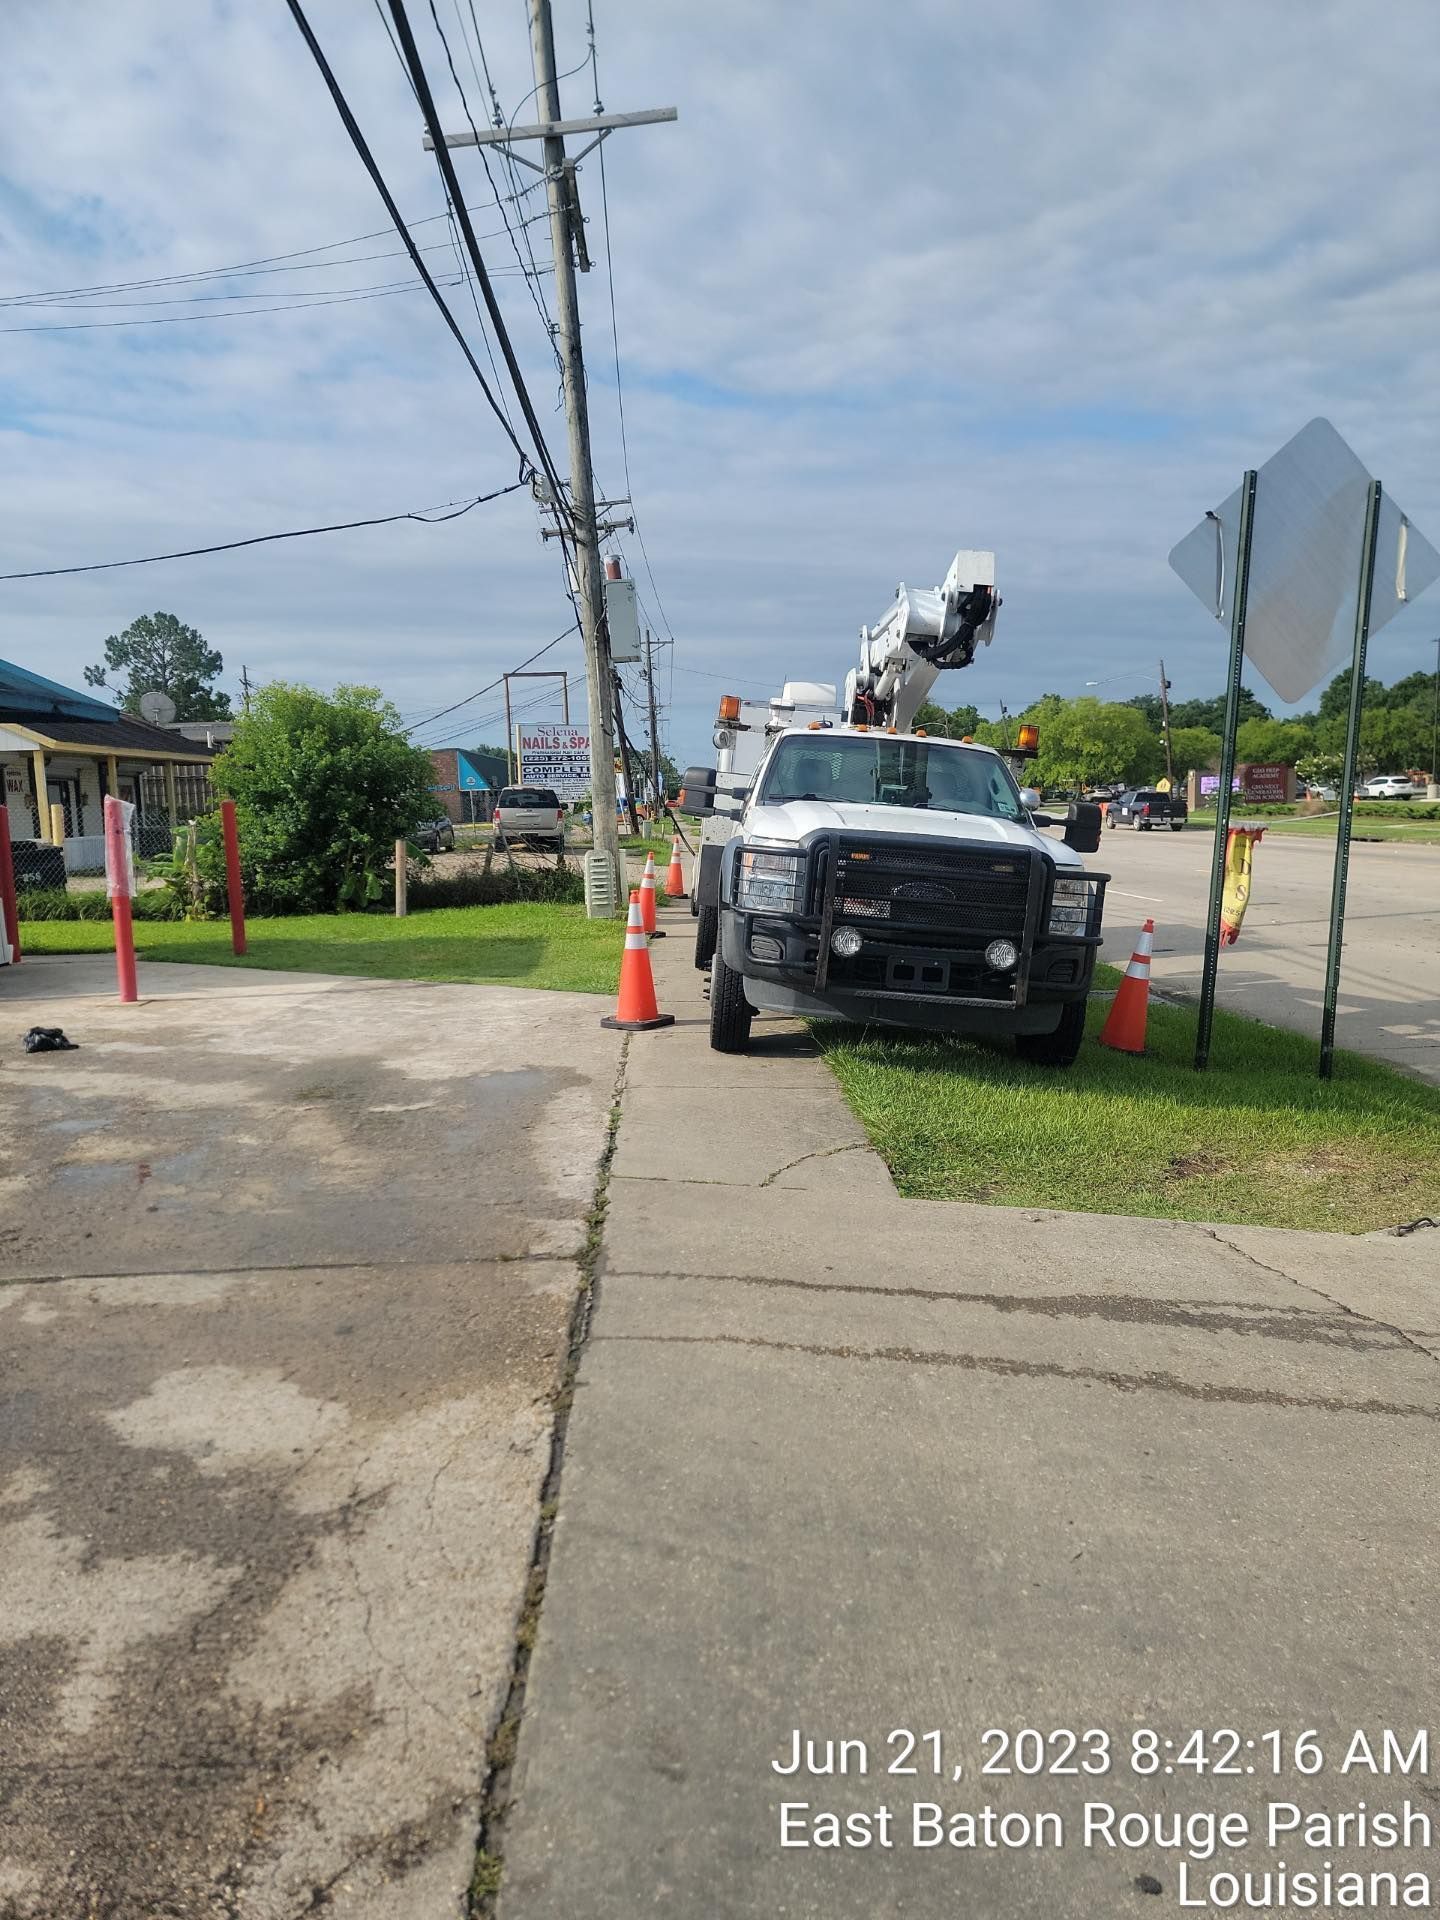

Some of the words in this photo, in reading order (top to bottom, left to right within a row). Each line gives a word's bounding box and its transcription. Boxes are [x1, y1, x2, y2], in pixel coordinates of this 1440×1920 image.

[537, 726, 578, 736] Selena
[522, 737, 561, 749] NAILS
[562, 741, 569, 749] &
[6, 779, 23, 792] WAX
